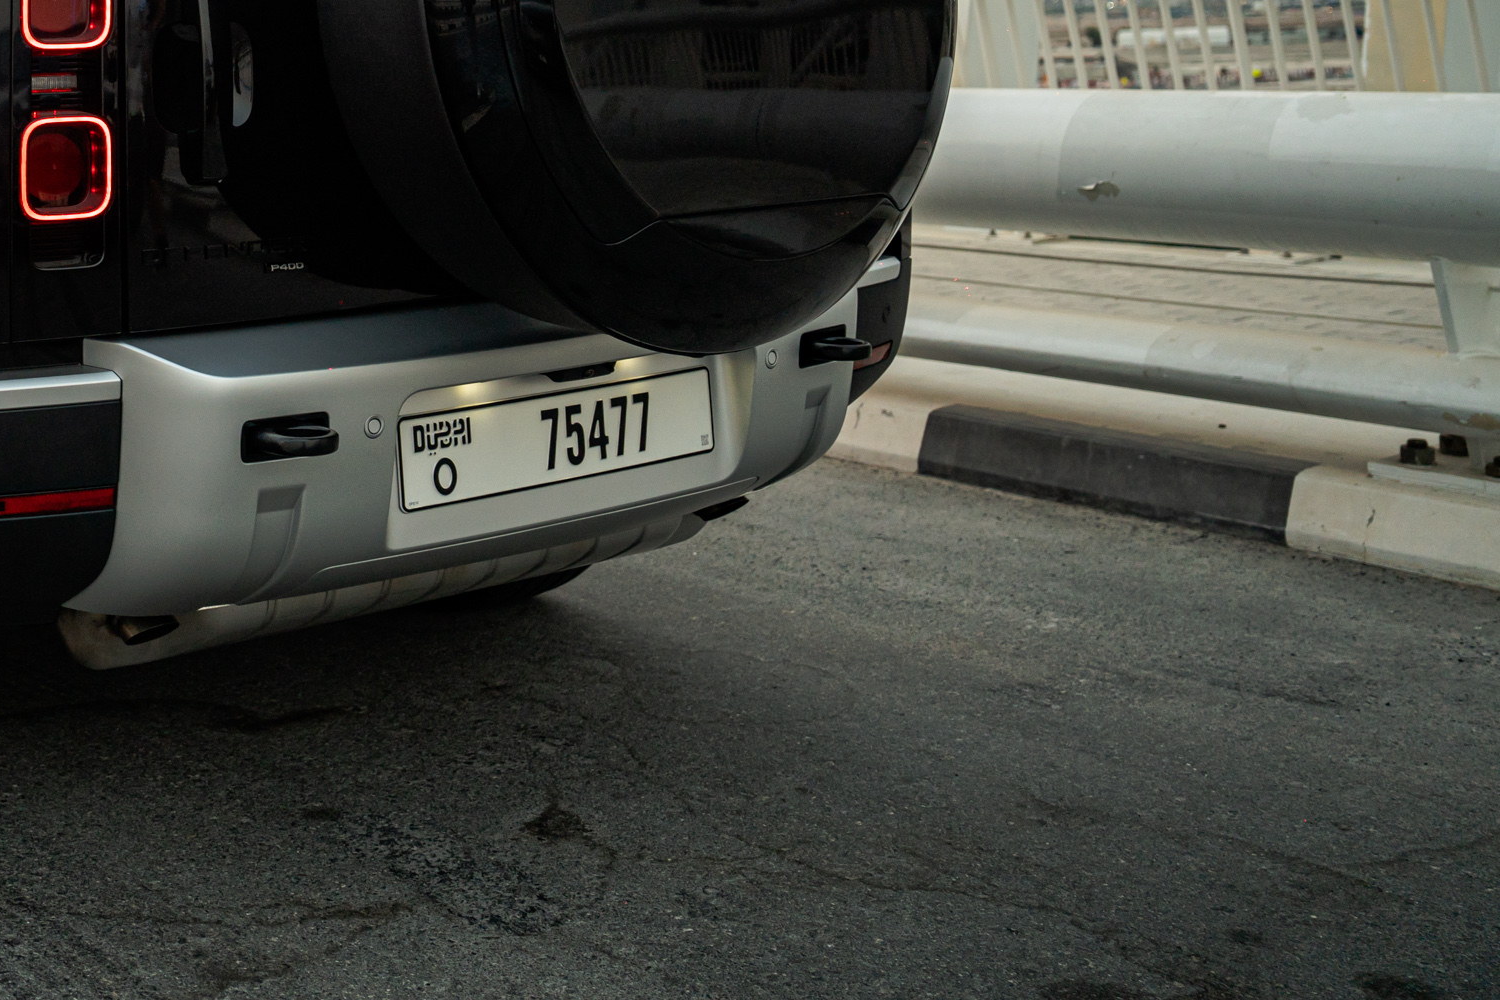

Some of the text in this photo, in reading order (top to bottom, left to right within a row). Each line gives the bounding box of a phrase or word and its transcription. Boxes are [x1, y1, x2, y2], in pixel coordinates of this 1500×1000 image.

[270, 262, 305, 272] P400
[540, 391, 650, 470] 75477
[433, 457, 458, 496] O
